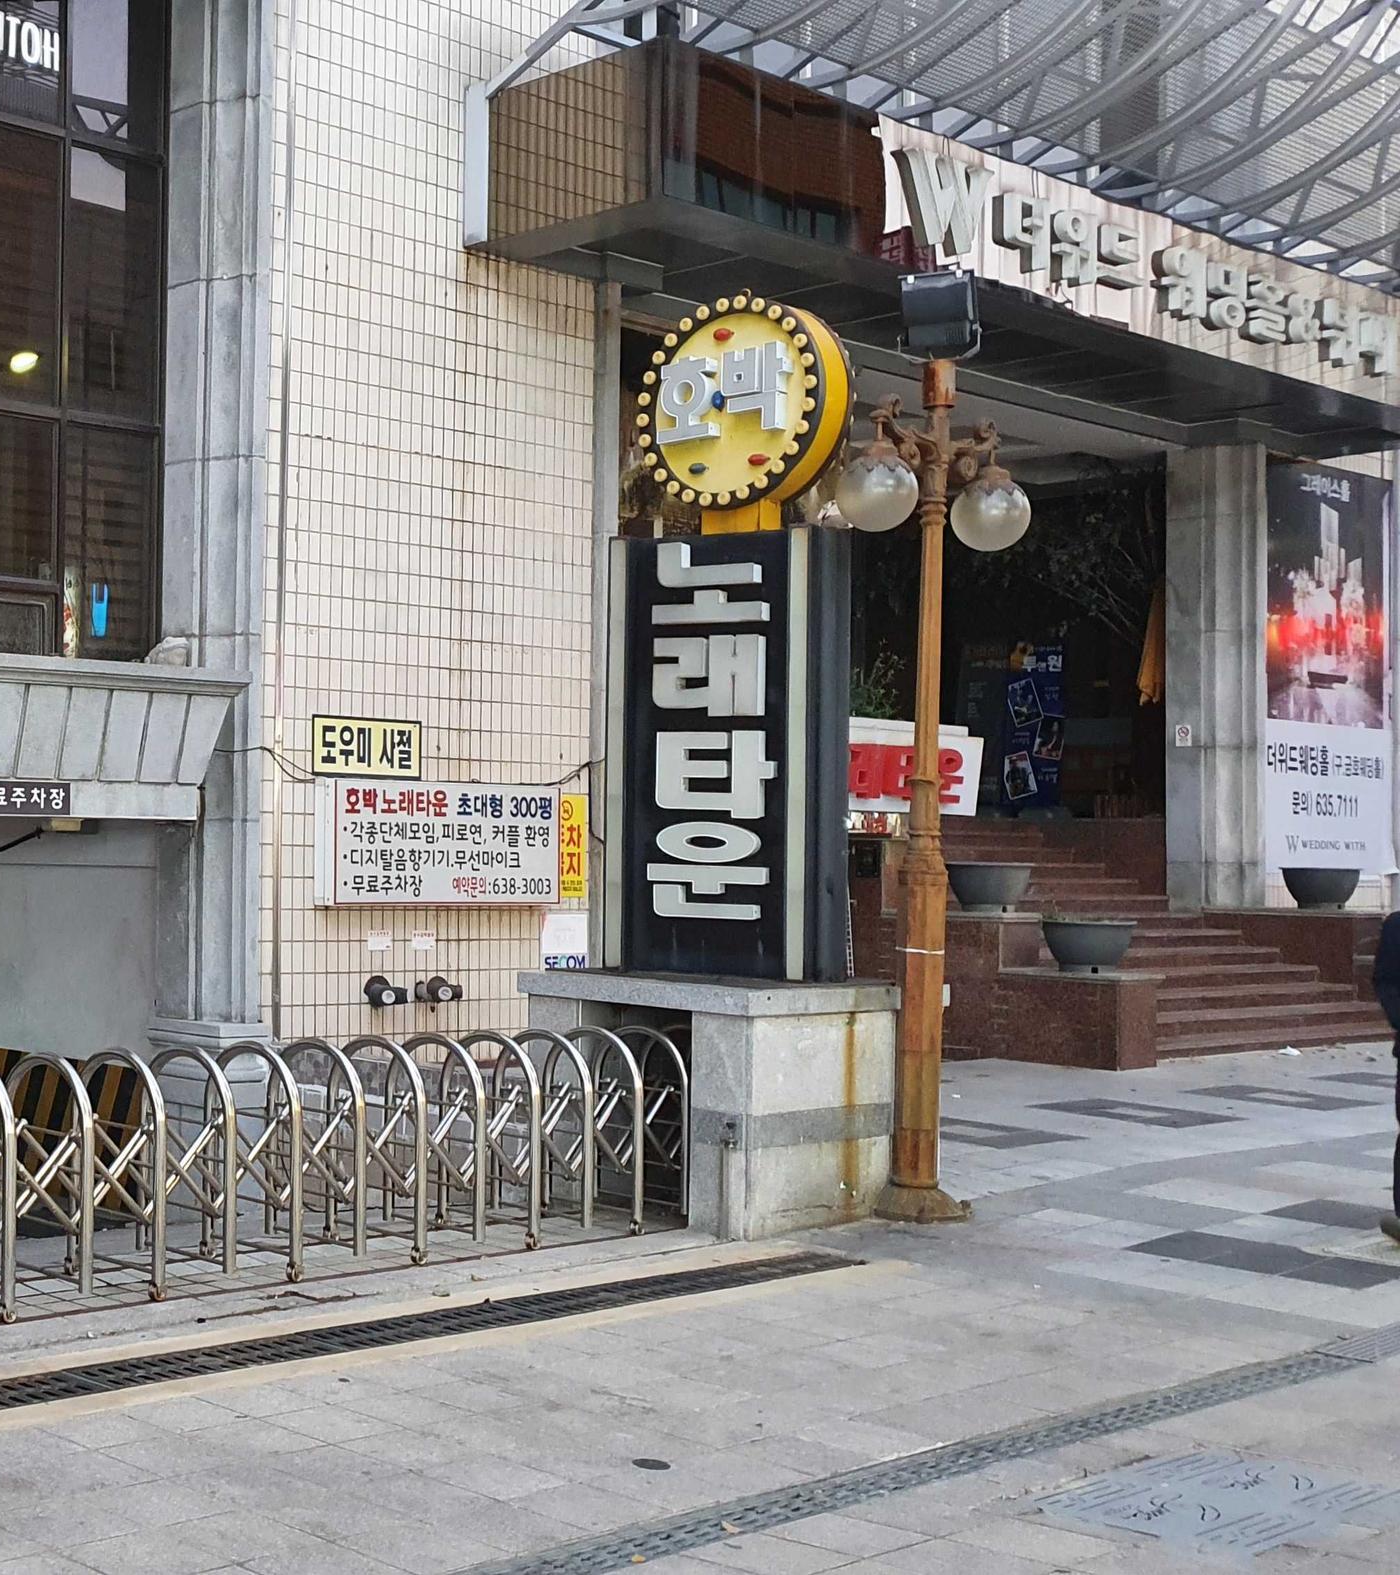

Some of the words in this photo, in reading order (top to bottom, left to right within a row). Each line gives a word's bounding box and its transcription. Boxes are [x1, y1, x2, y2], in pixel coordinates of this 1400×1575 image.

[891, 147, 995, 257] W
[656, 340, 794, 446] 호박
[646, 541, 779, 921] 노래타운
[321, 725, 372, 768] 도우미
[379, 728, 412, 769] 사절
[457, 793, 503, 818] 초대형
[510, 796, 552, 820] 300평
[492, 824, 520, 848] 커플
[525, 825, 550, 848] 환영
[561, 824, 581, 849] 차
[1301, 839, 1340, 851] WEDDING
[1344, 840, 1366, 851] WITH
[561, 852, 581, 876] 지
[351, 875, 423, 897] 무료주차장
[545, 956, 586, 969] SECOM
